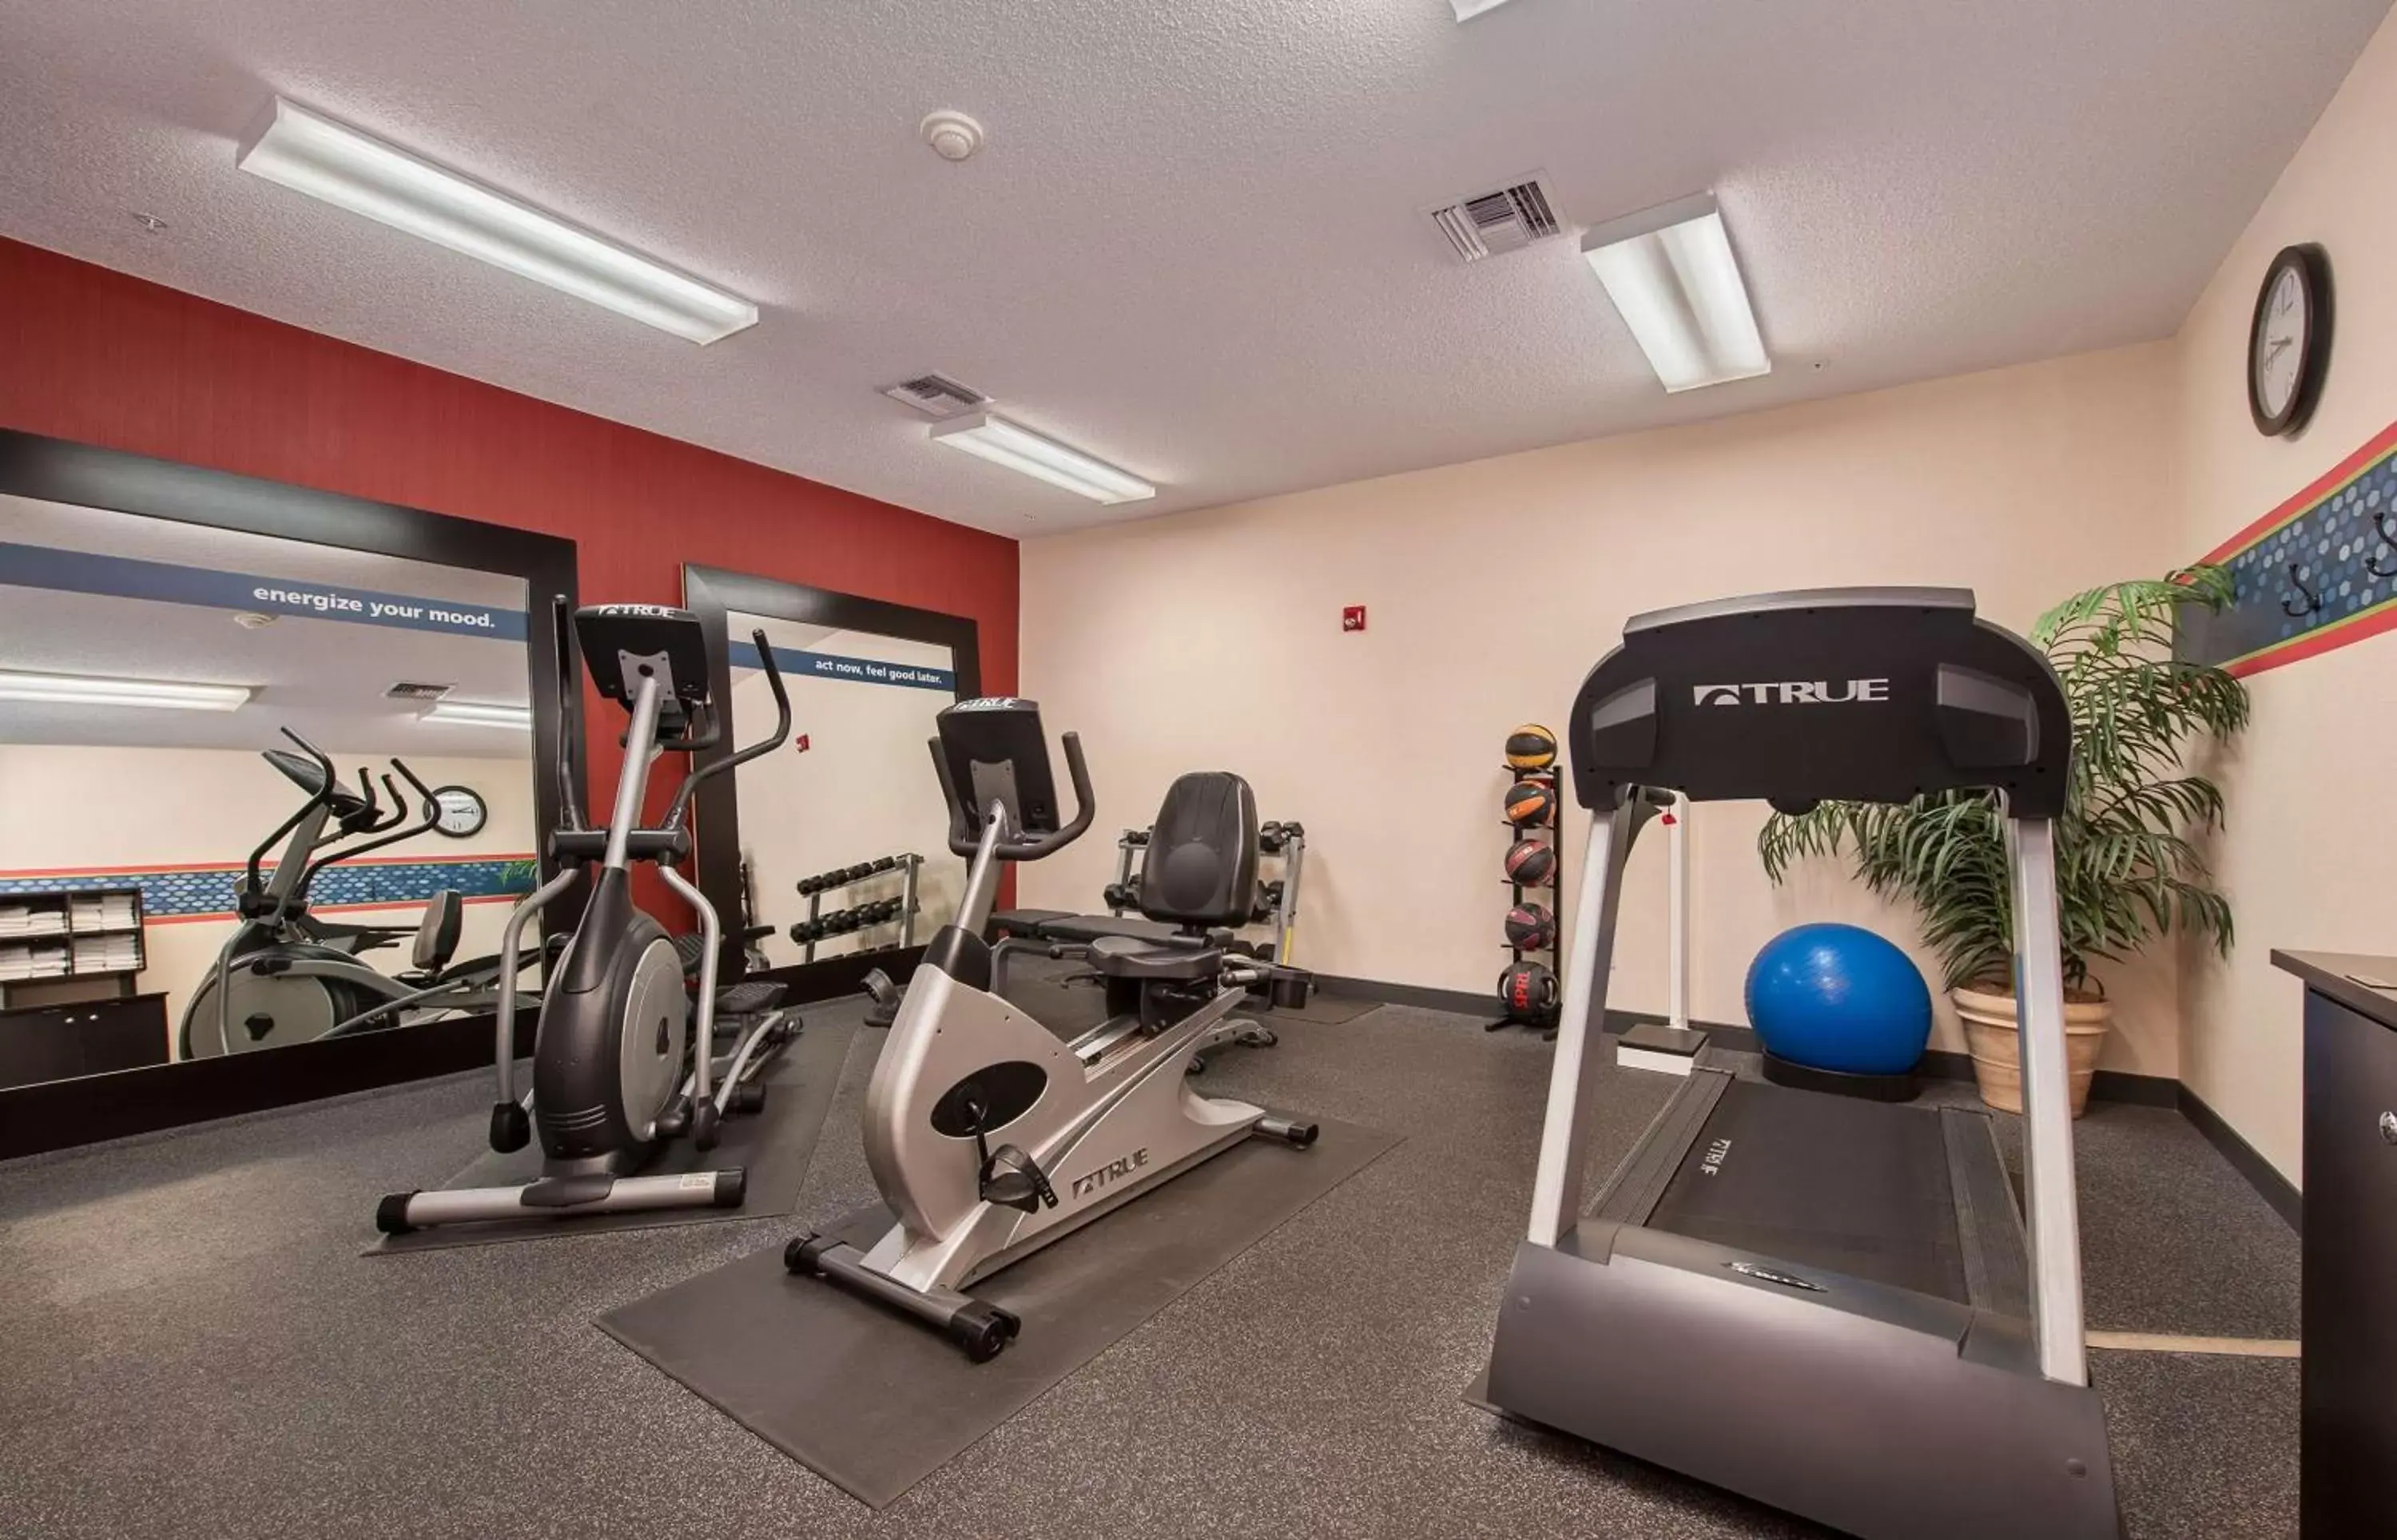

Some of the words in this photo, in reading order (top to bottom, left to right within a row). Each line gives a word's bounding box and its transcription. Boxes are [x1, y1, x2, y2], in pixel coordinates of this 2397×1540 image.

[252, 586, 364, 611] energize
[370, 601, 423, 619] your
[428, 609, 496, 628] mood.
[815, 660, 833, 671] act
[837, 663, 864, 676] now,
[865, 665, 886, 677] feel
[888, 669, 915, 681] good
[916, 671, 942, 685] later.
[1741, 678, 1889, 705] TRUE
[1092, 1147, 1148, 1188] TRUE
